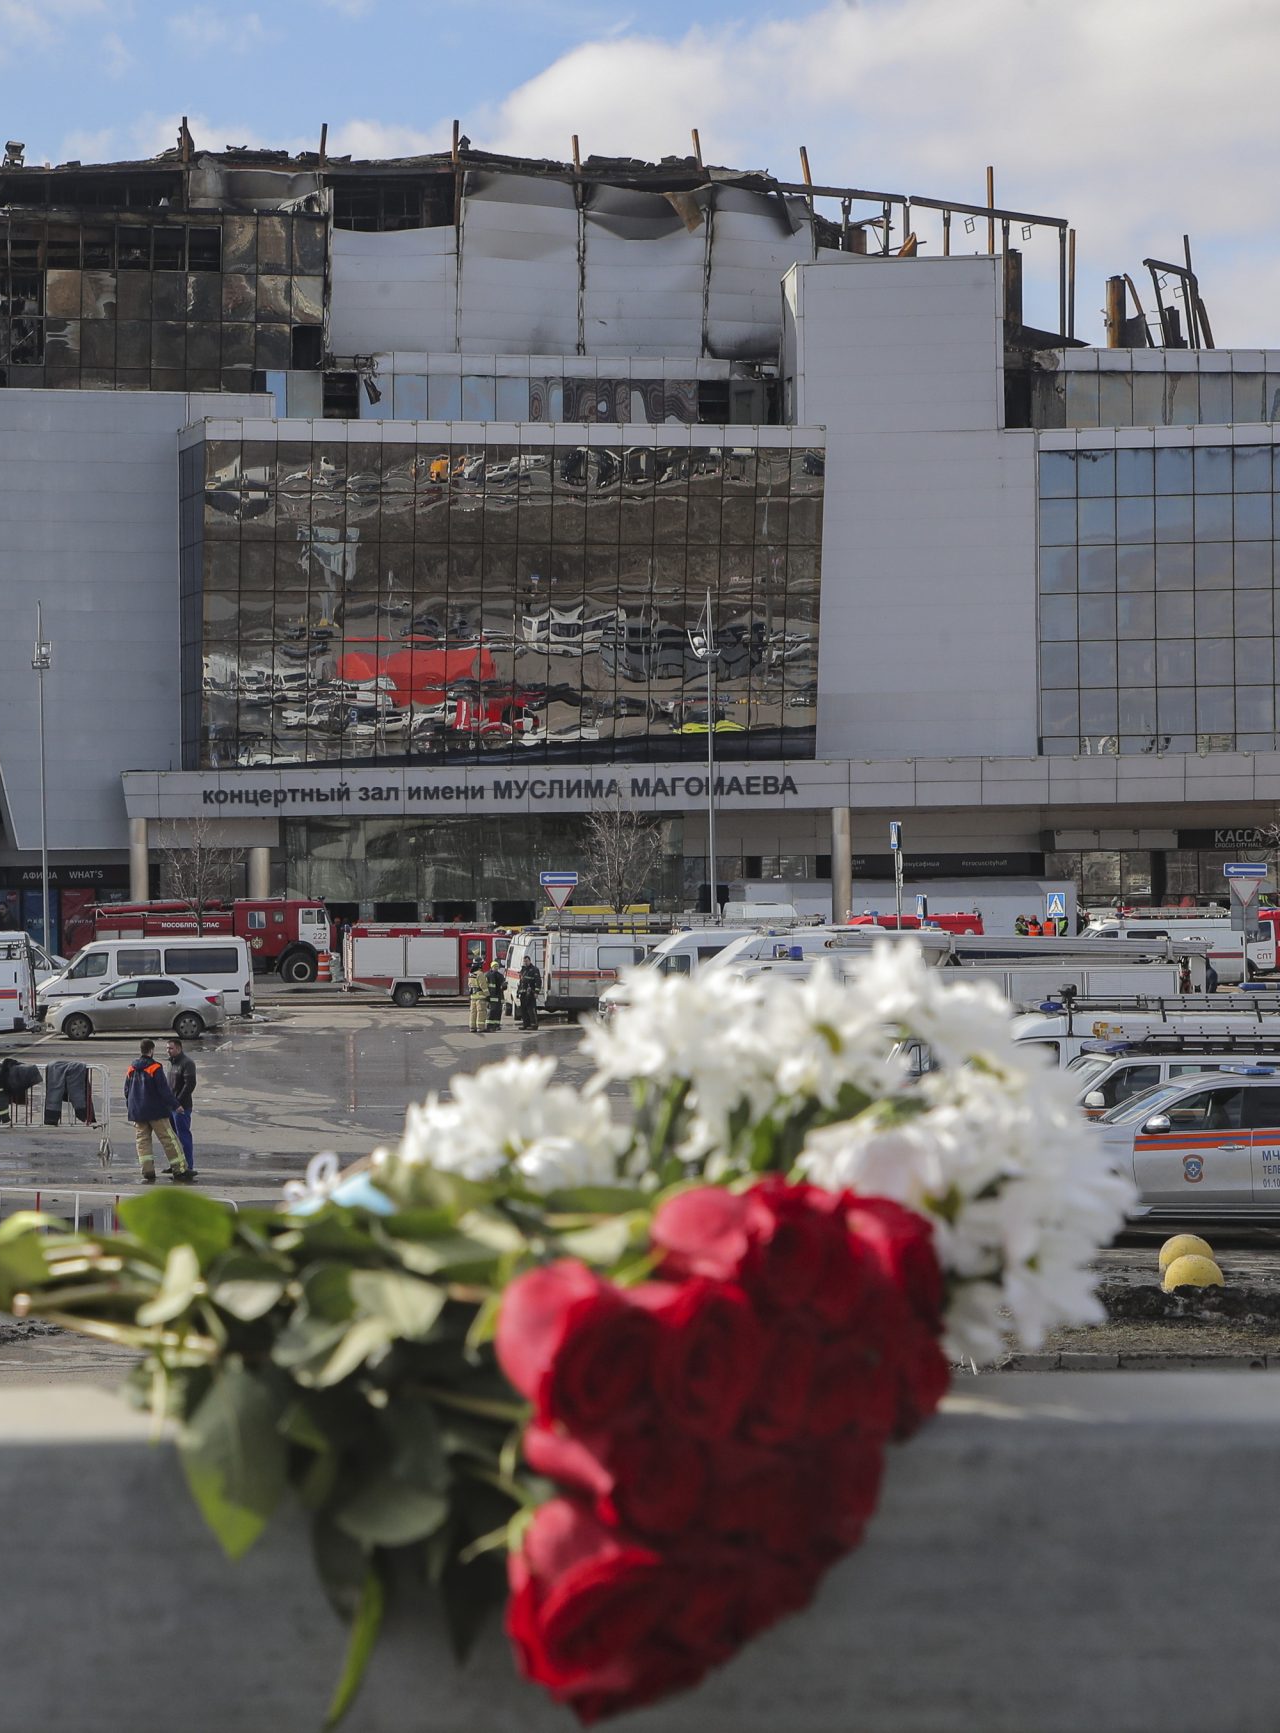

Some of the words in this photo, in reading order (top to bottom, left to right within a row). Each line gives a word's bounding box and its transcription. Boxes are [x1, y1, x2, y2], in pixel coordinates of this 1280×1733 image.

[203, 782, 350, 807] концертный
[359, 786, 399, 801] зал
[408, 784, 484, 800] имени
[493, 779, 622, 800] МУСЛИМА
[631, 775, 798, 797] МАГОМАЕВА
[1215, 830, 1262, 842] КАССА
[69, 870, 104, 879] WHAT'S
